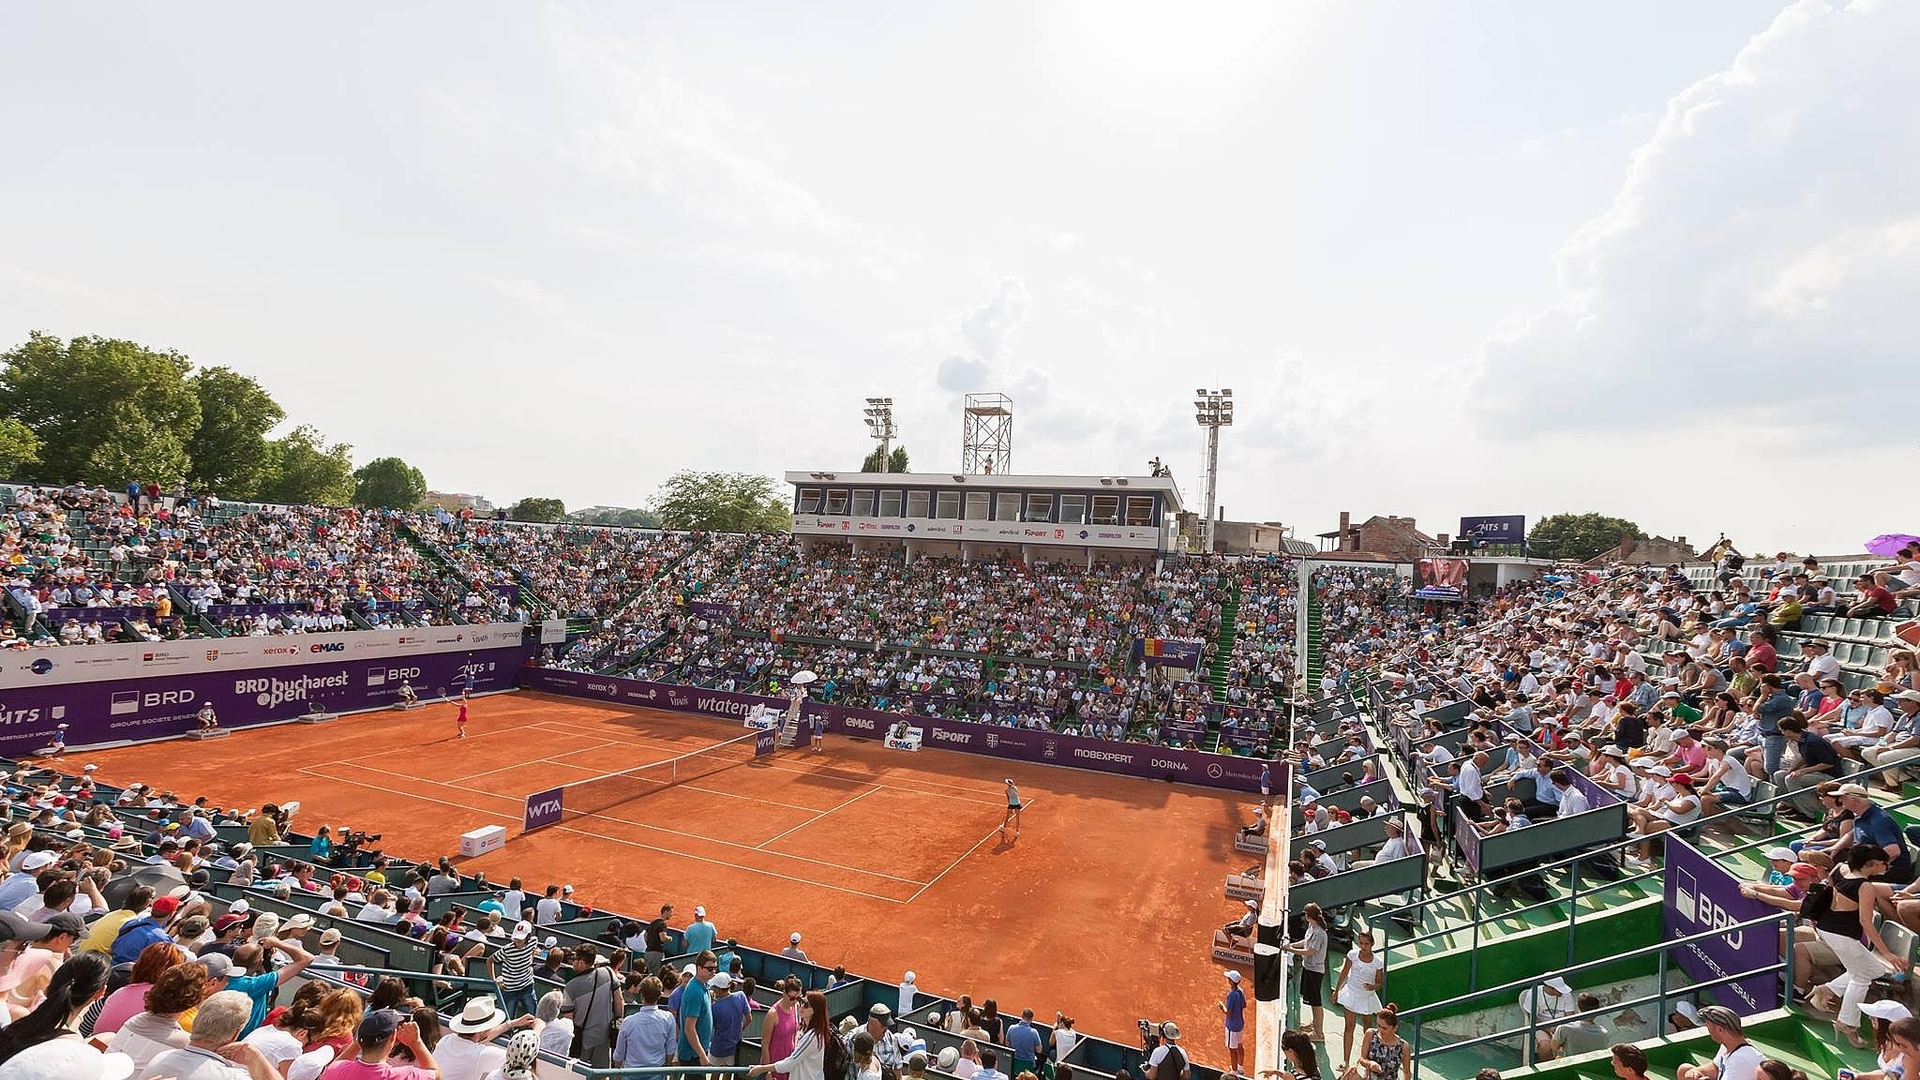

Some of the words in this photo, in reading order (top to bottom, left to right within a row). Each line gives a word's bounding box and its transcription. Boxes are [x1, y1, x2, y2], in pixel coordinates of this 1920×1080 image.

[310, 642, 344, 653] eMAG
[388, 667, 420, 680] BRD
[236, 678, 269, 694] BRD
[271, 670, 348, 694] bucharest
[587, 682, 607, 692] xerox
[144, 690, 195, 707] BRD
[256, 688, 306, 709] open
[845, 716, 875, 730] eMAG
[890, 740, 912, 750] eMAG
[1074, 748, 1134, 764] MOBEXPERT
[1151, 758, 1188, 772] DORNA
[528, 799, 561, 819] WTA
[1699, 892, 1743, 950] BRD
